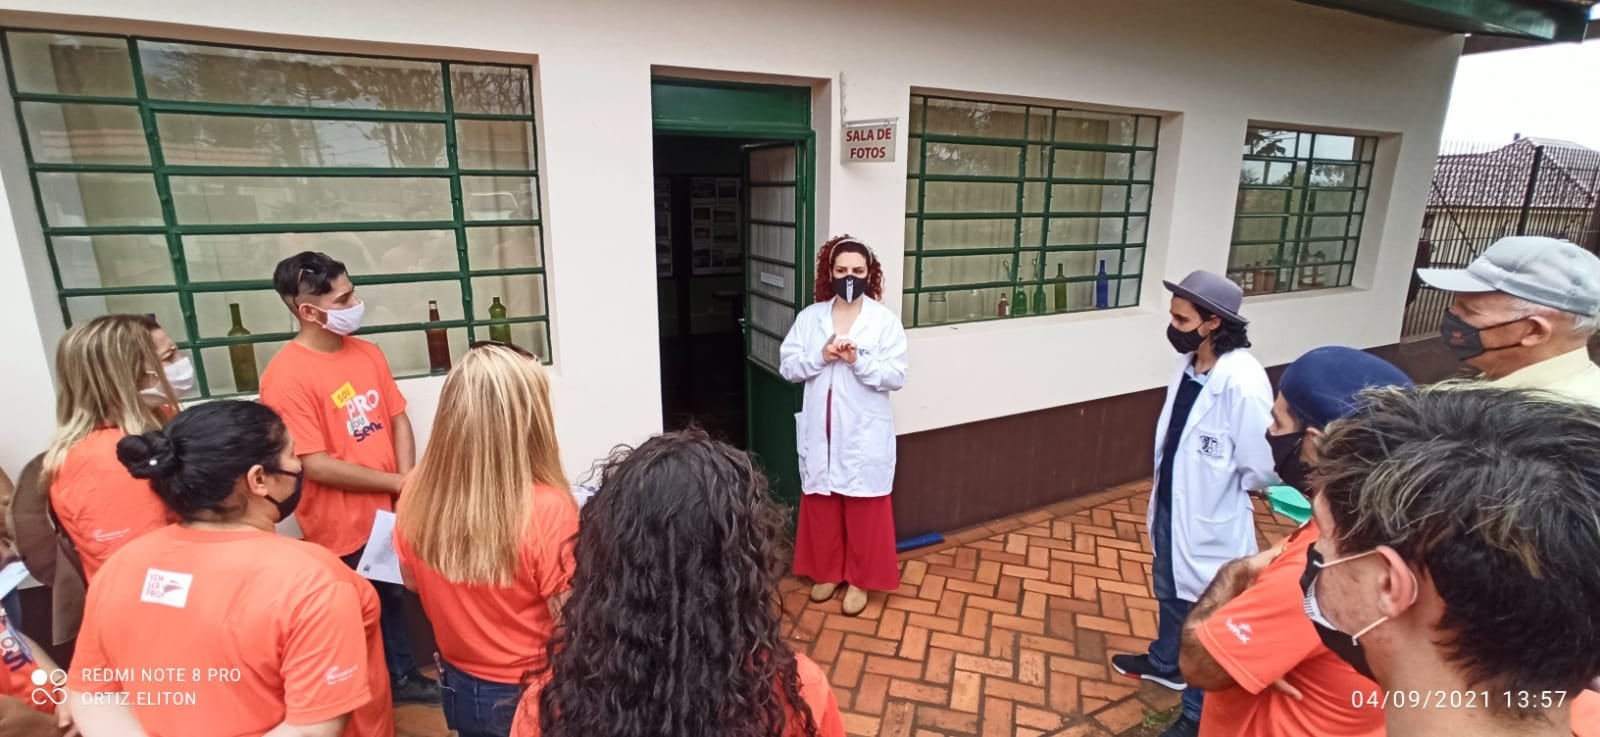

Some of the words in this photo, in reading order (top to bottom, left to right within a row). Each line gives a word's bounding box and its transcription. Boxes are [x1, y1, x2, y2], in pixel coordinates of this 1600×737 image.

[846, 129, 874, 142] SALA
[877, 128, 892, 140] DE
[850, 147, 886, 159] FOTOS
[346, 389, 380, 420] PRO
